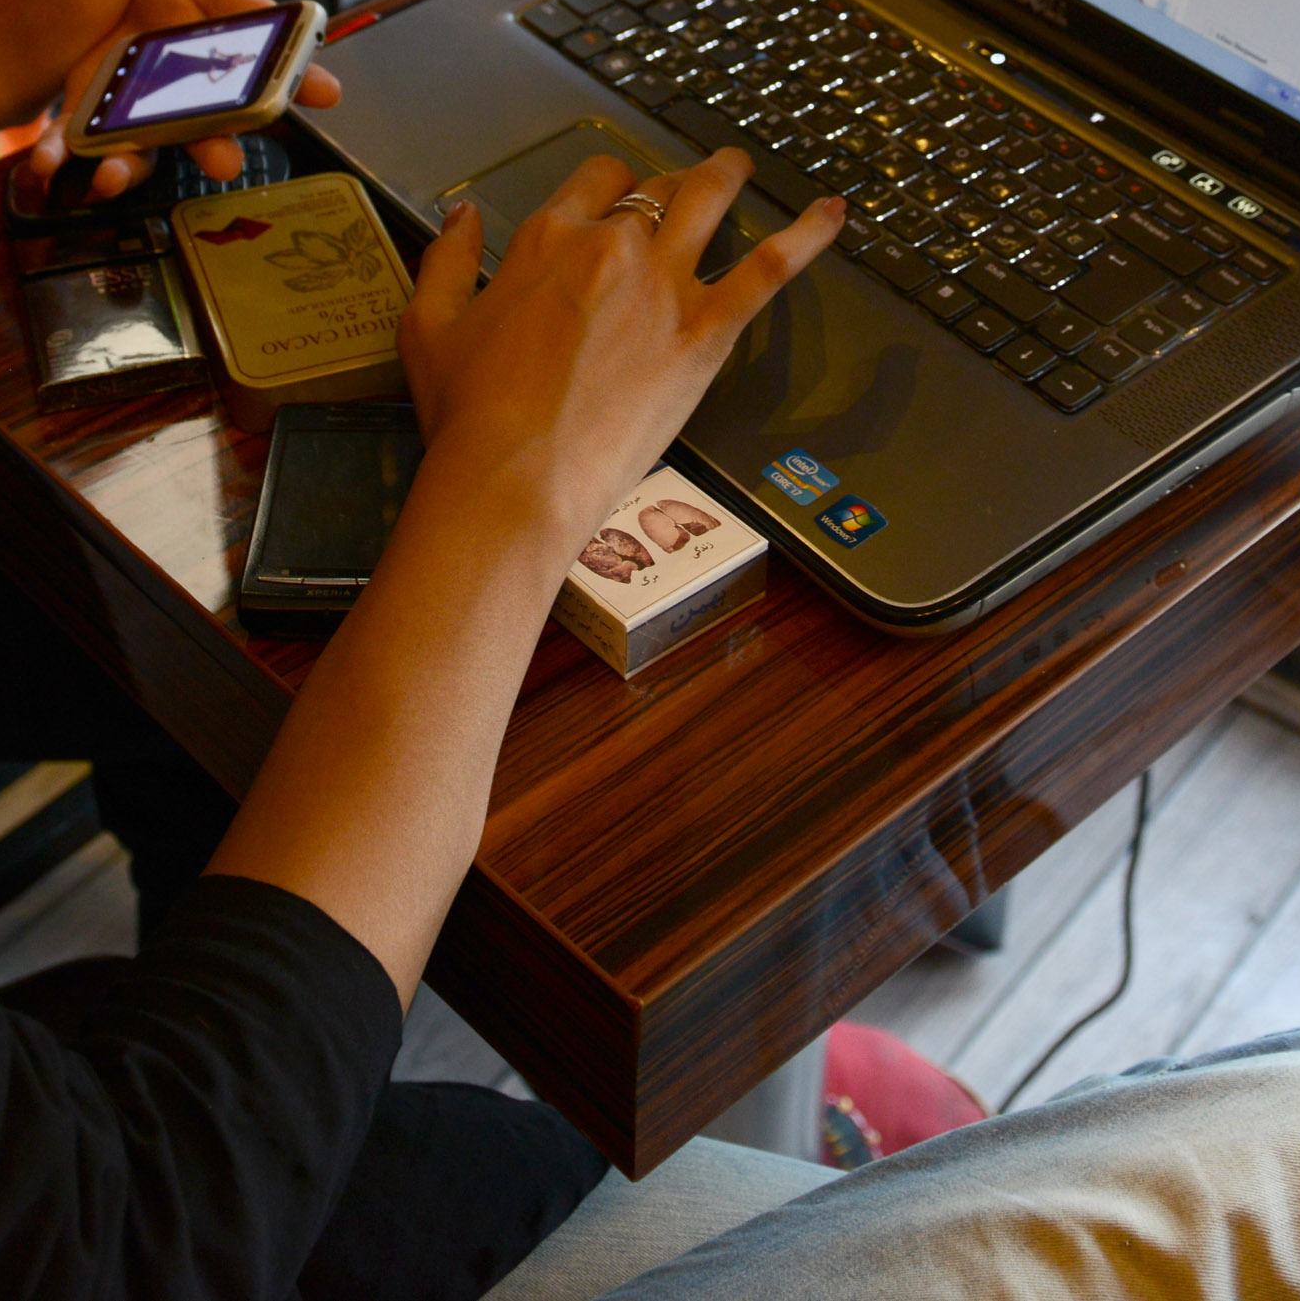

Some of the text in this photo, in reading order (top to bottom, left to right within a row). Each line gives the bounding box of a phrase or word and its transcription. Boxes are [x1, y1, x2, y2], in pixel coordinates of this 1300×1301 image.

[88, 265, 152, 291] ESSE
[317, 298, 398, 326] 72.5%
[260, 314, 402, 356] HIGH CACAO
[770, 471, 792, 490] CORE
[306, 588, 351, 597] XPERIA
